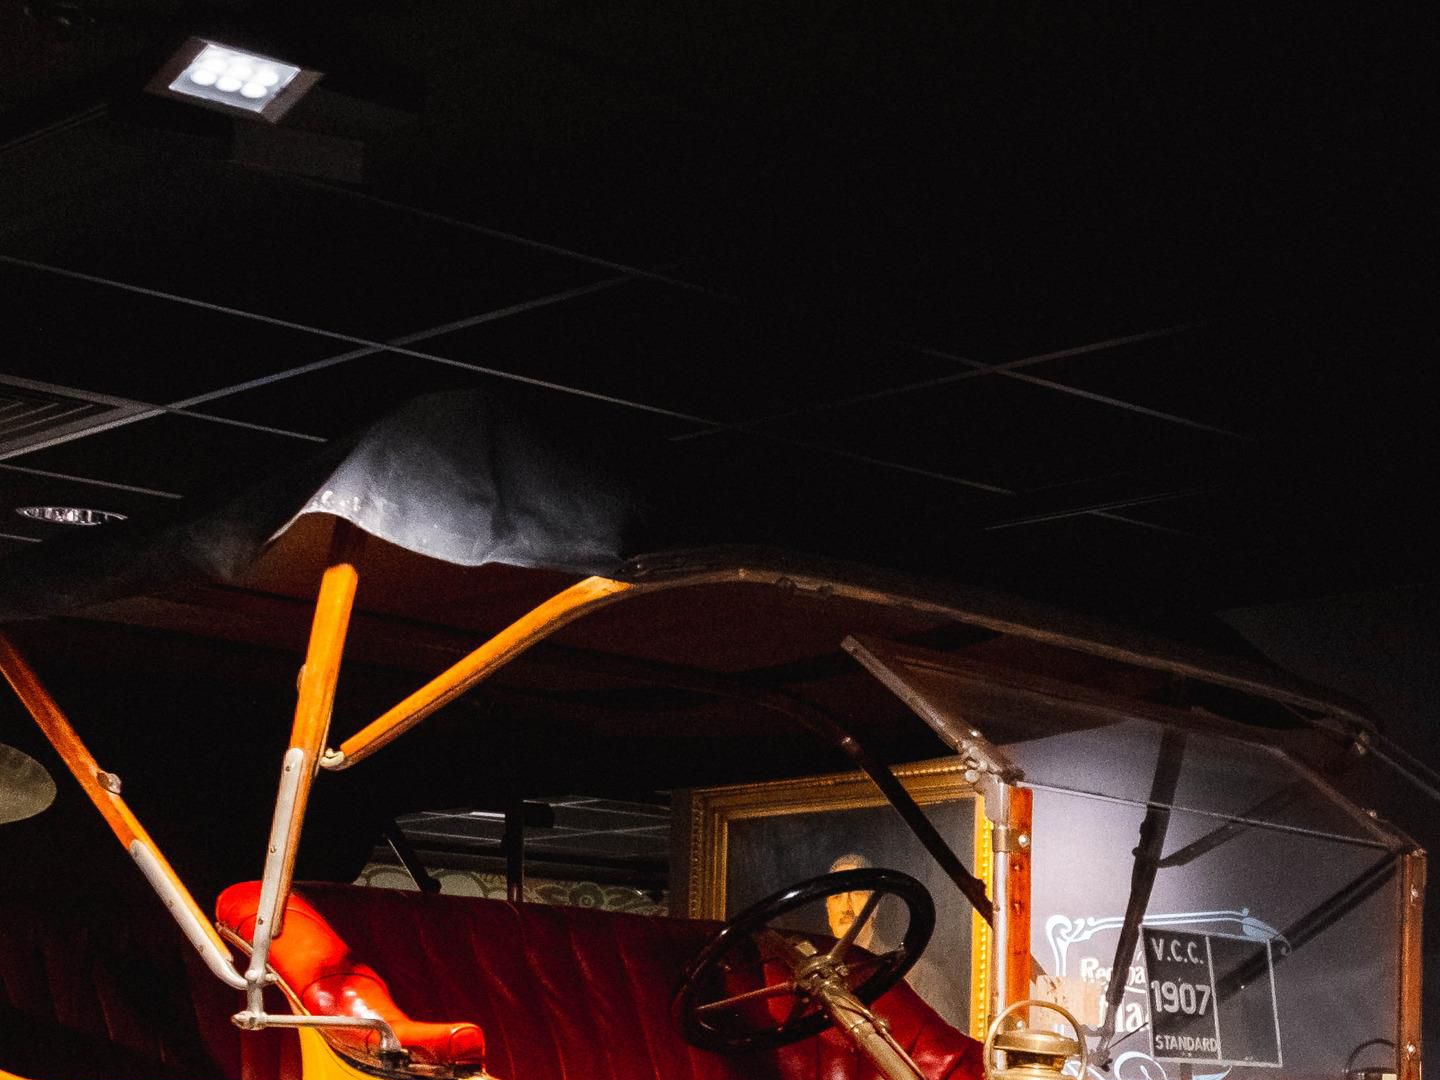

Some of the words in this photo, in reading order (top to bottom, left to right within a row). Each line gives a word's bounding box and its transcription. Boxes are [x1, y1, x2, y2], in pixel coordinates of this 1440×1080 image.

[1151, 937, 1205, 965] V.C.C.
[1151, 980, 1211, 1016] 1907
[1155, 1034, 1219, 1053] STANDARD
